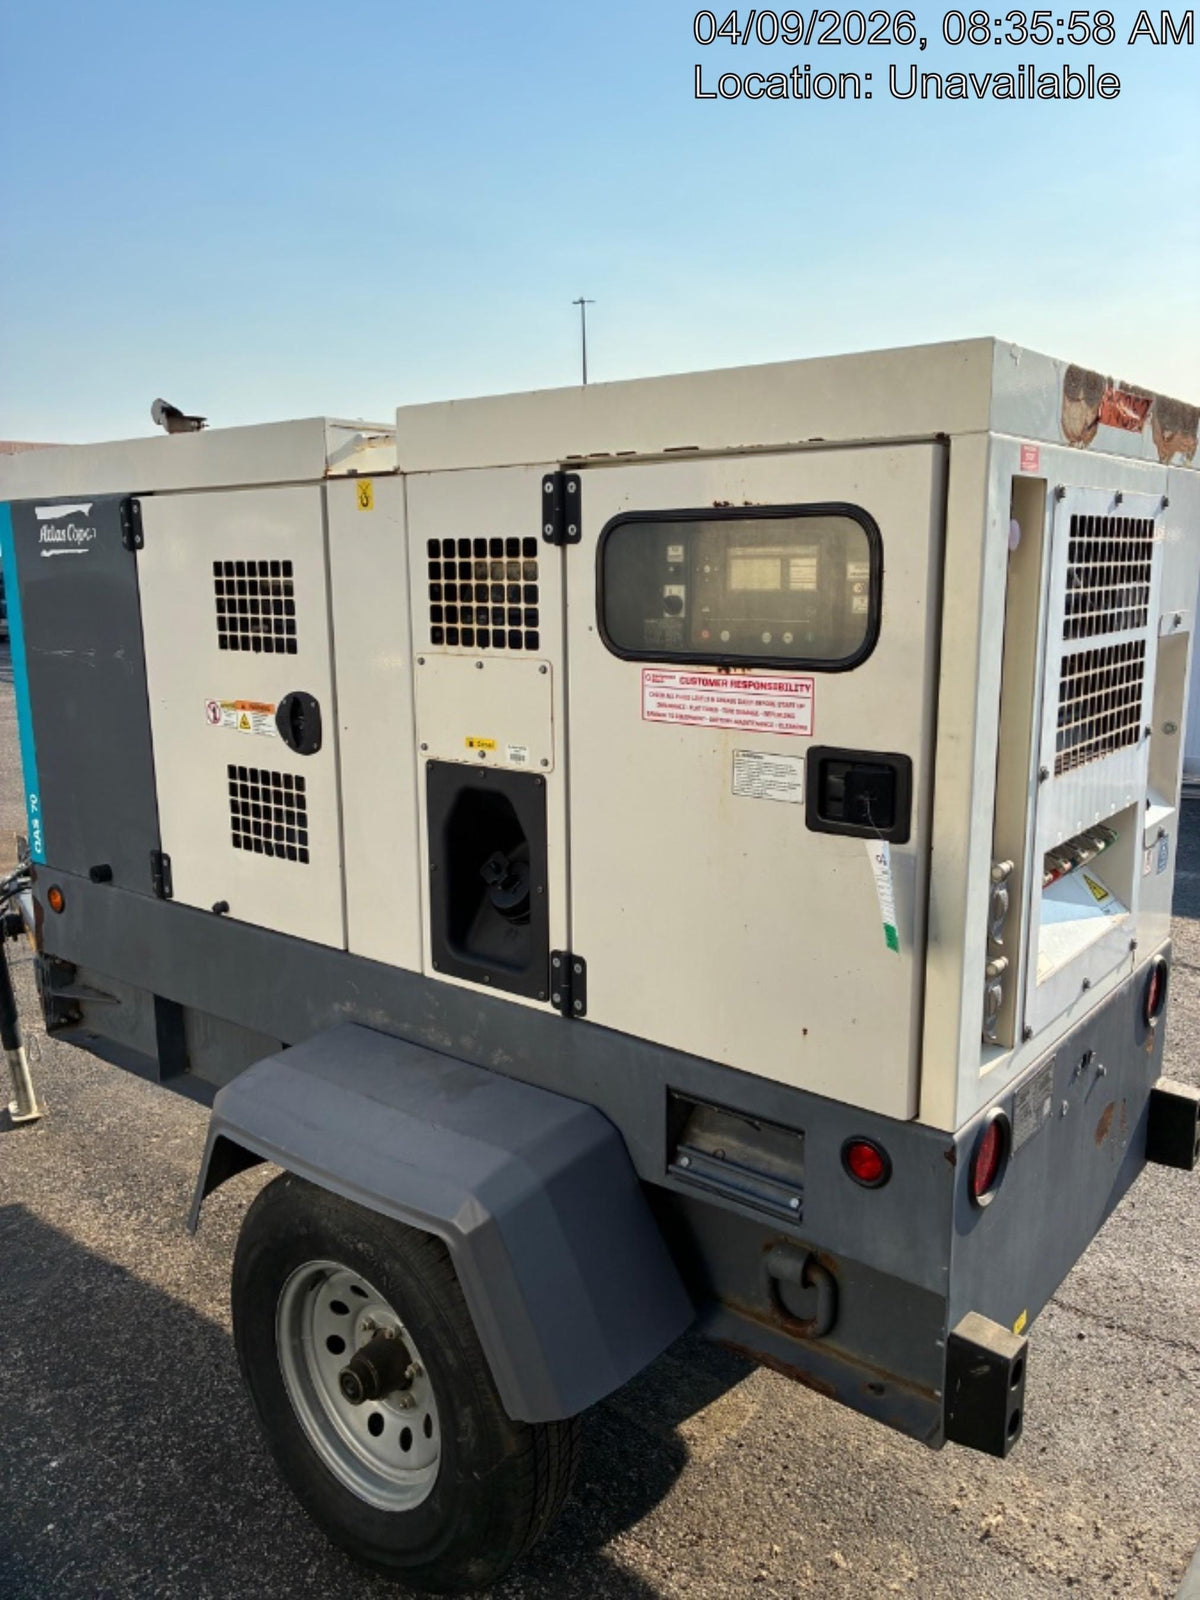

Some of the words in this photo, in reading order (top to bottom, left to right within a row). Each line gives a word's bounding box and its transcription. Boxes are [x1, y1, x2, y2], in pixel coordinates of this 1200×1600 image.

[39, 524, 66, 543] Atlas
[679, 676, 728, 687] CUSTOMER
[731, 680, 811, 693] RESPONSIBILITY
